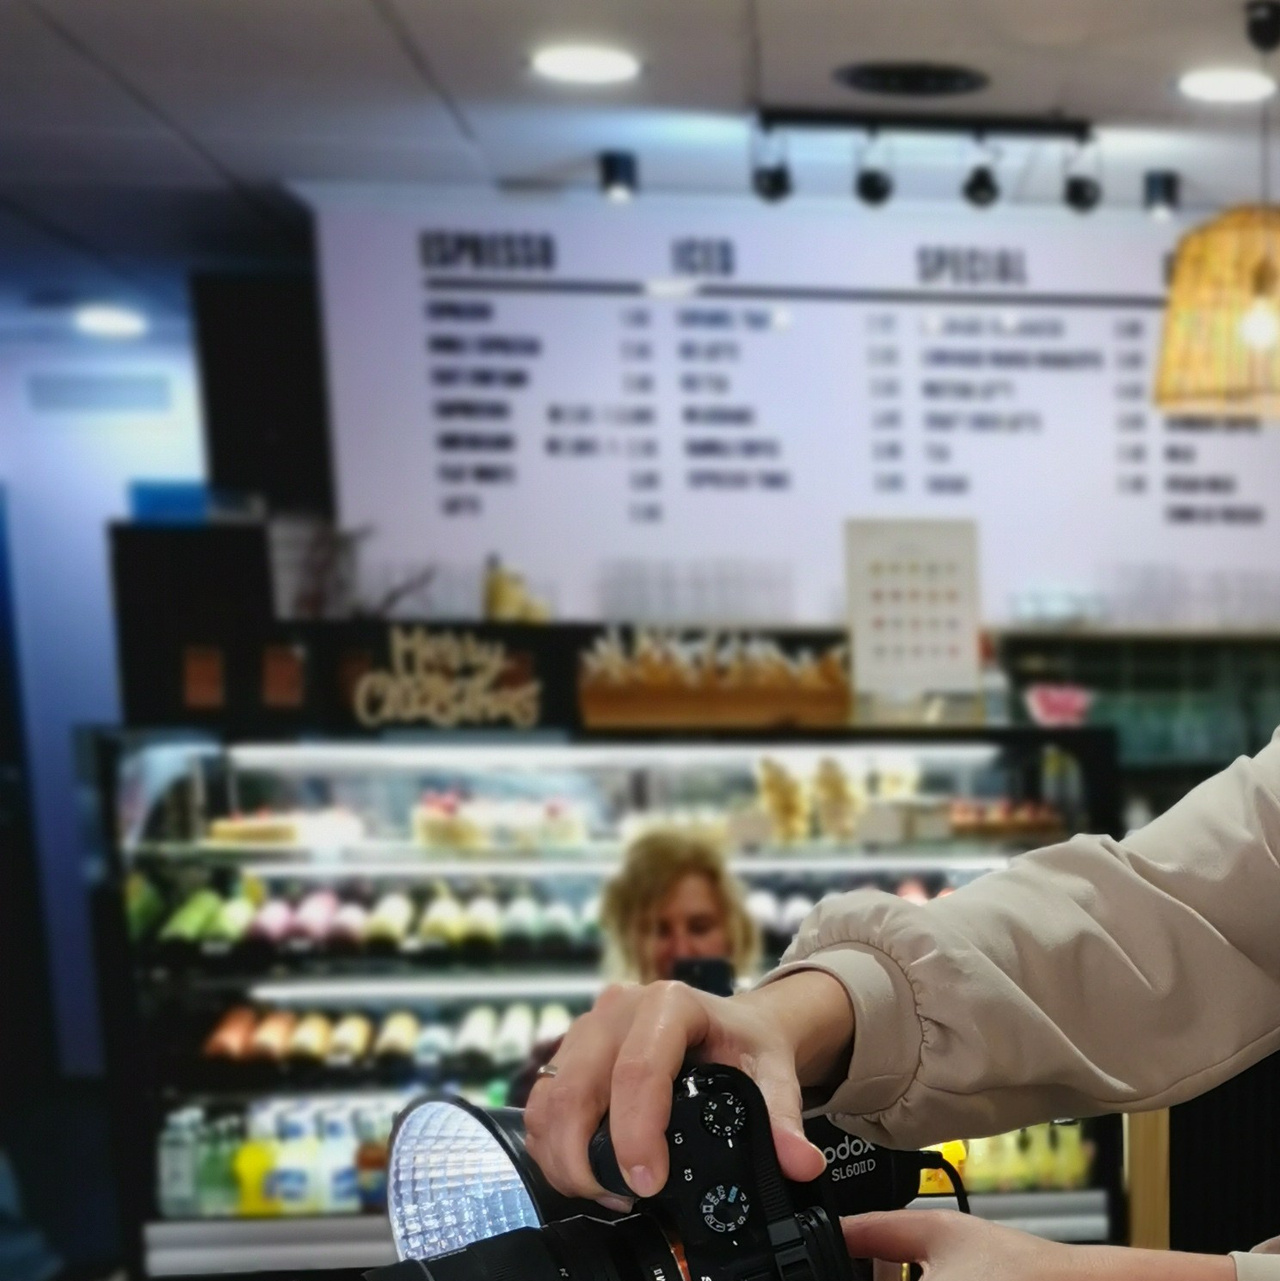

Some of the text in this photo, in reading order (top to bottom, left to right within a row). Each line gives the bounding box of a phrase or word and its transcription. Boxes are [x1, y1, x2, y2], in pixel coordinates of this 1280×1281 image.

[674, 1131, 684, 1145] C1
[821, 1134, 877, 1165] odox
[683, 1168, 694, 1182] C2
